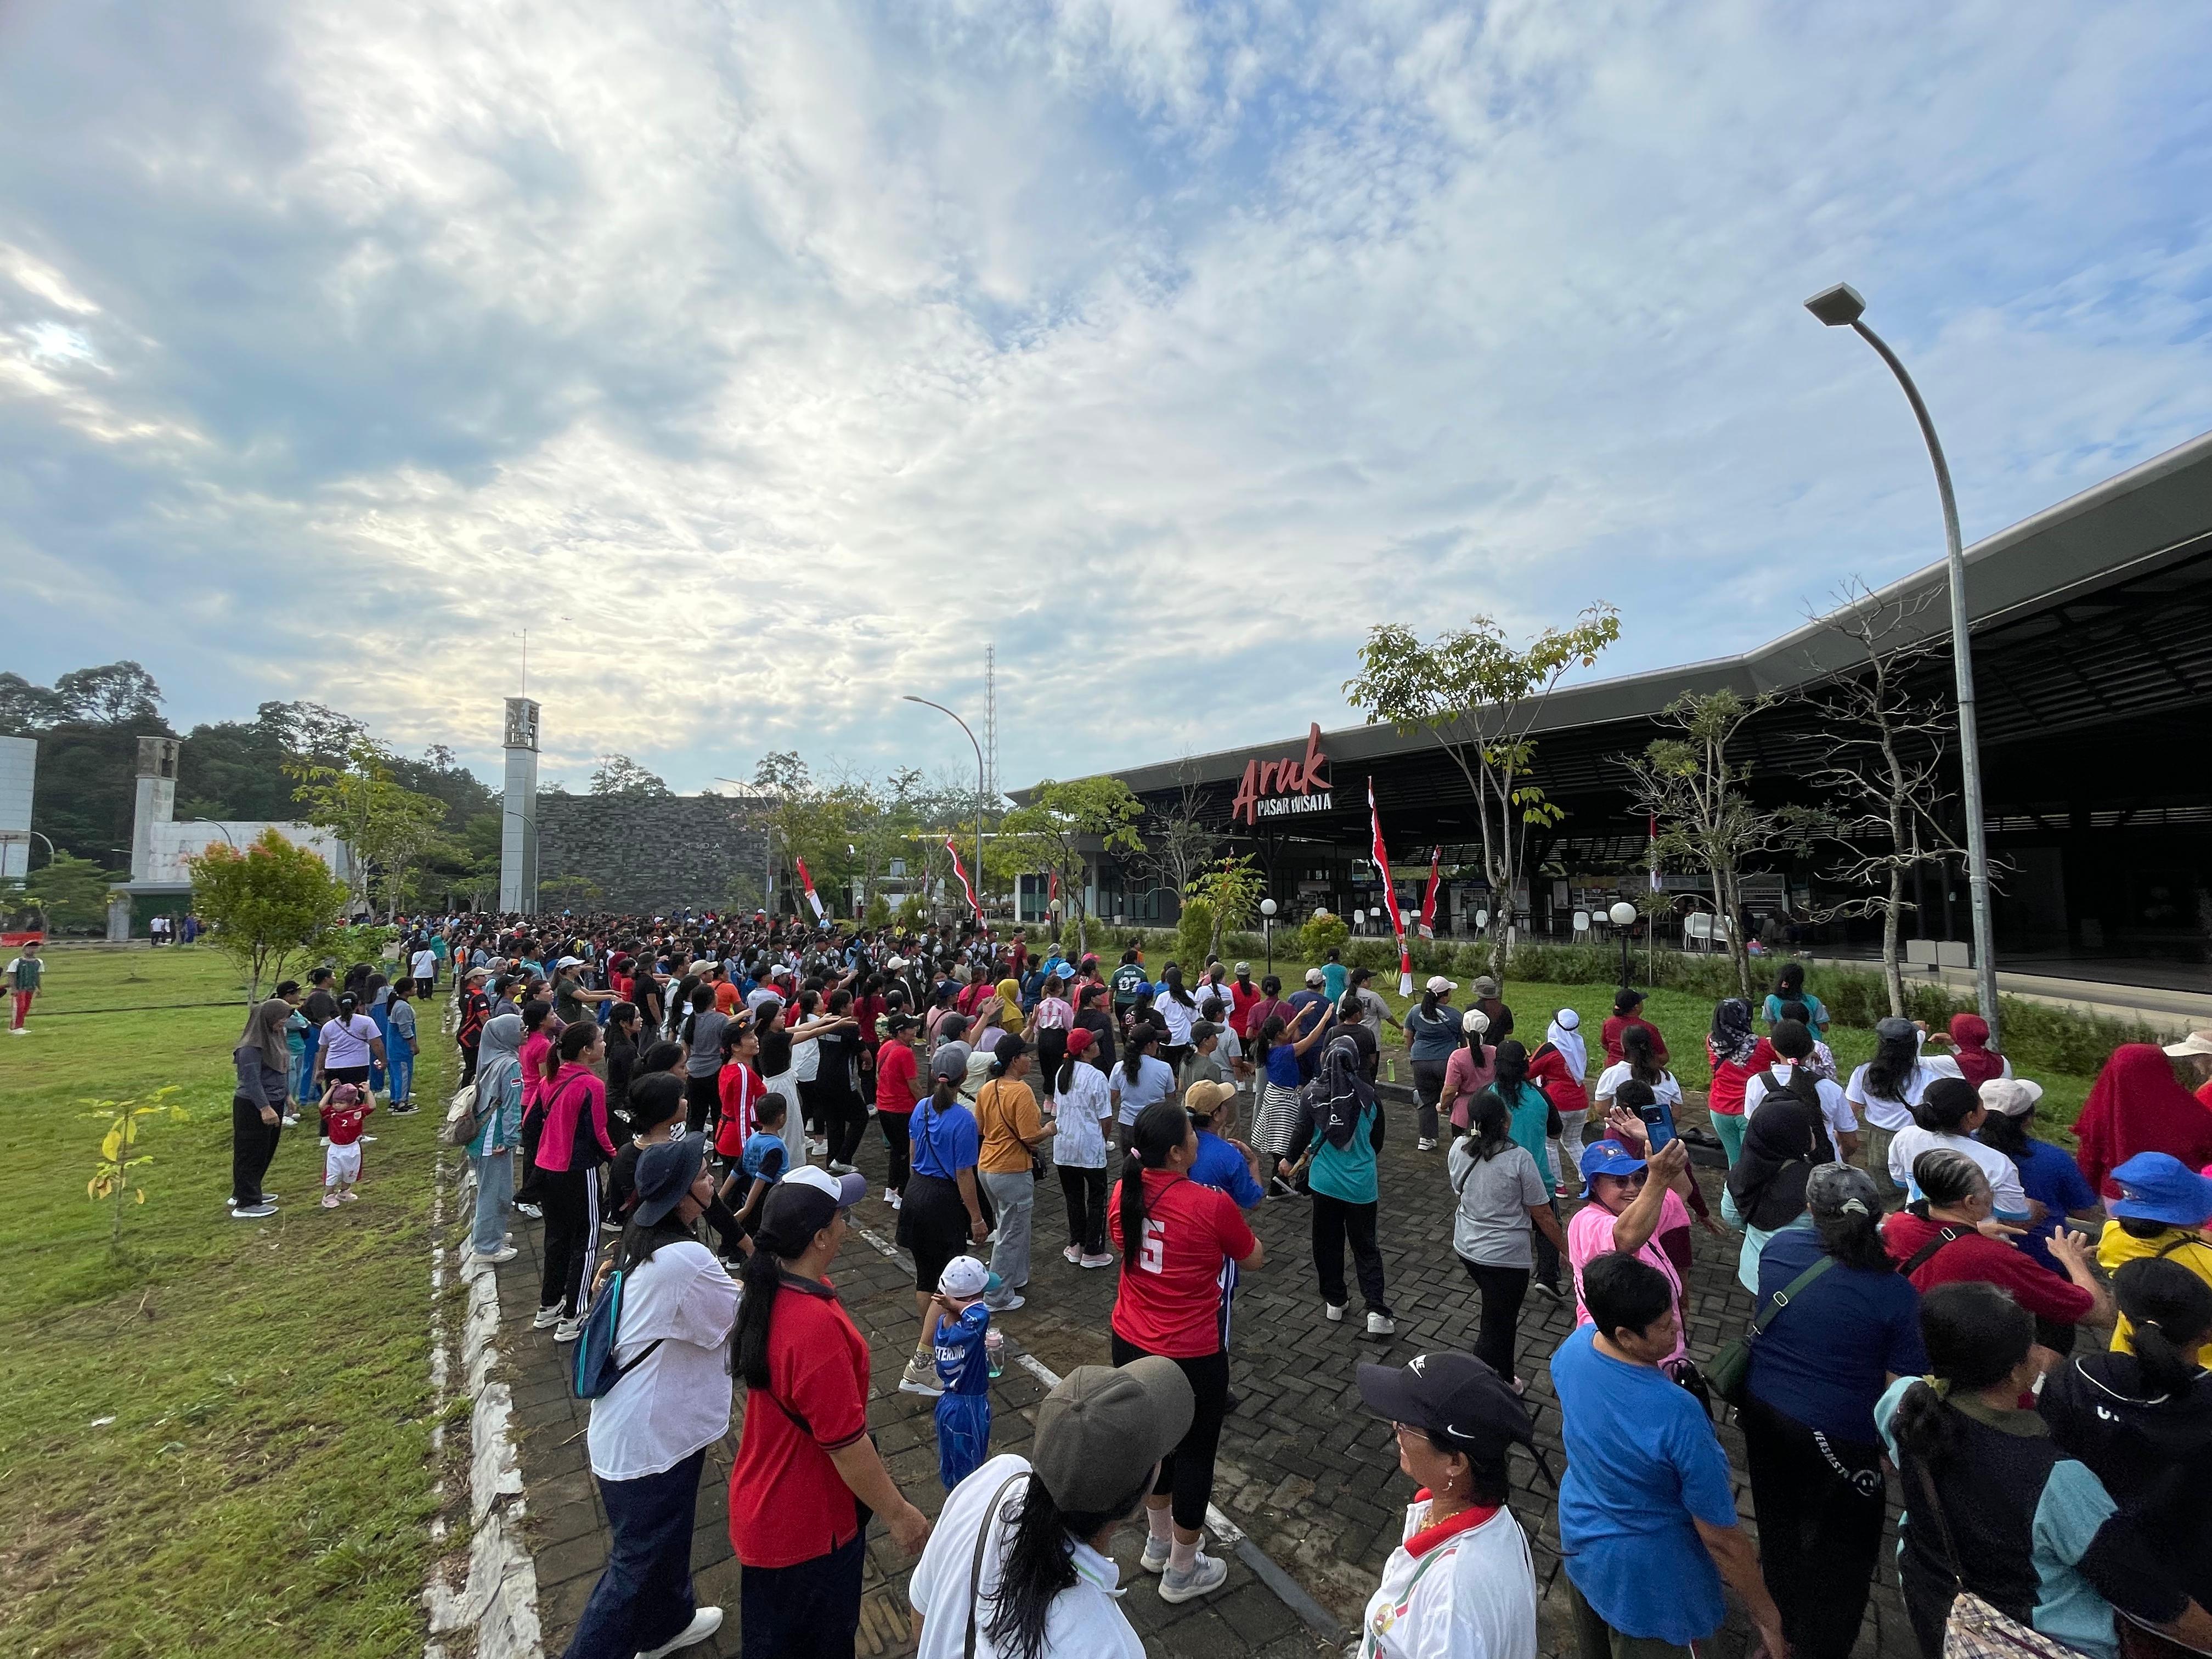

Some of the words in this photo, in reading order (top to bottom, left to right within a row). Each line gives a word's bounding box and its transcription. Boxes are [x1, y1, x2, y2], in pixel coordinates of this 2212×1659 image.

[1232, 722, 1334, 825] Aruk
[1257, 798, 1290, 816] PASAR
[1291, 792, 1332, 812] WISATA
[1140, 1217, 1165, 1274] 5
